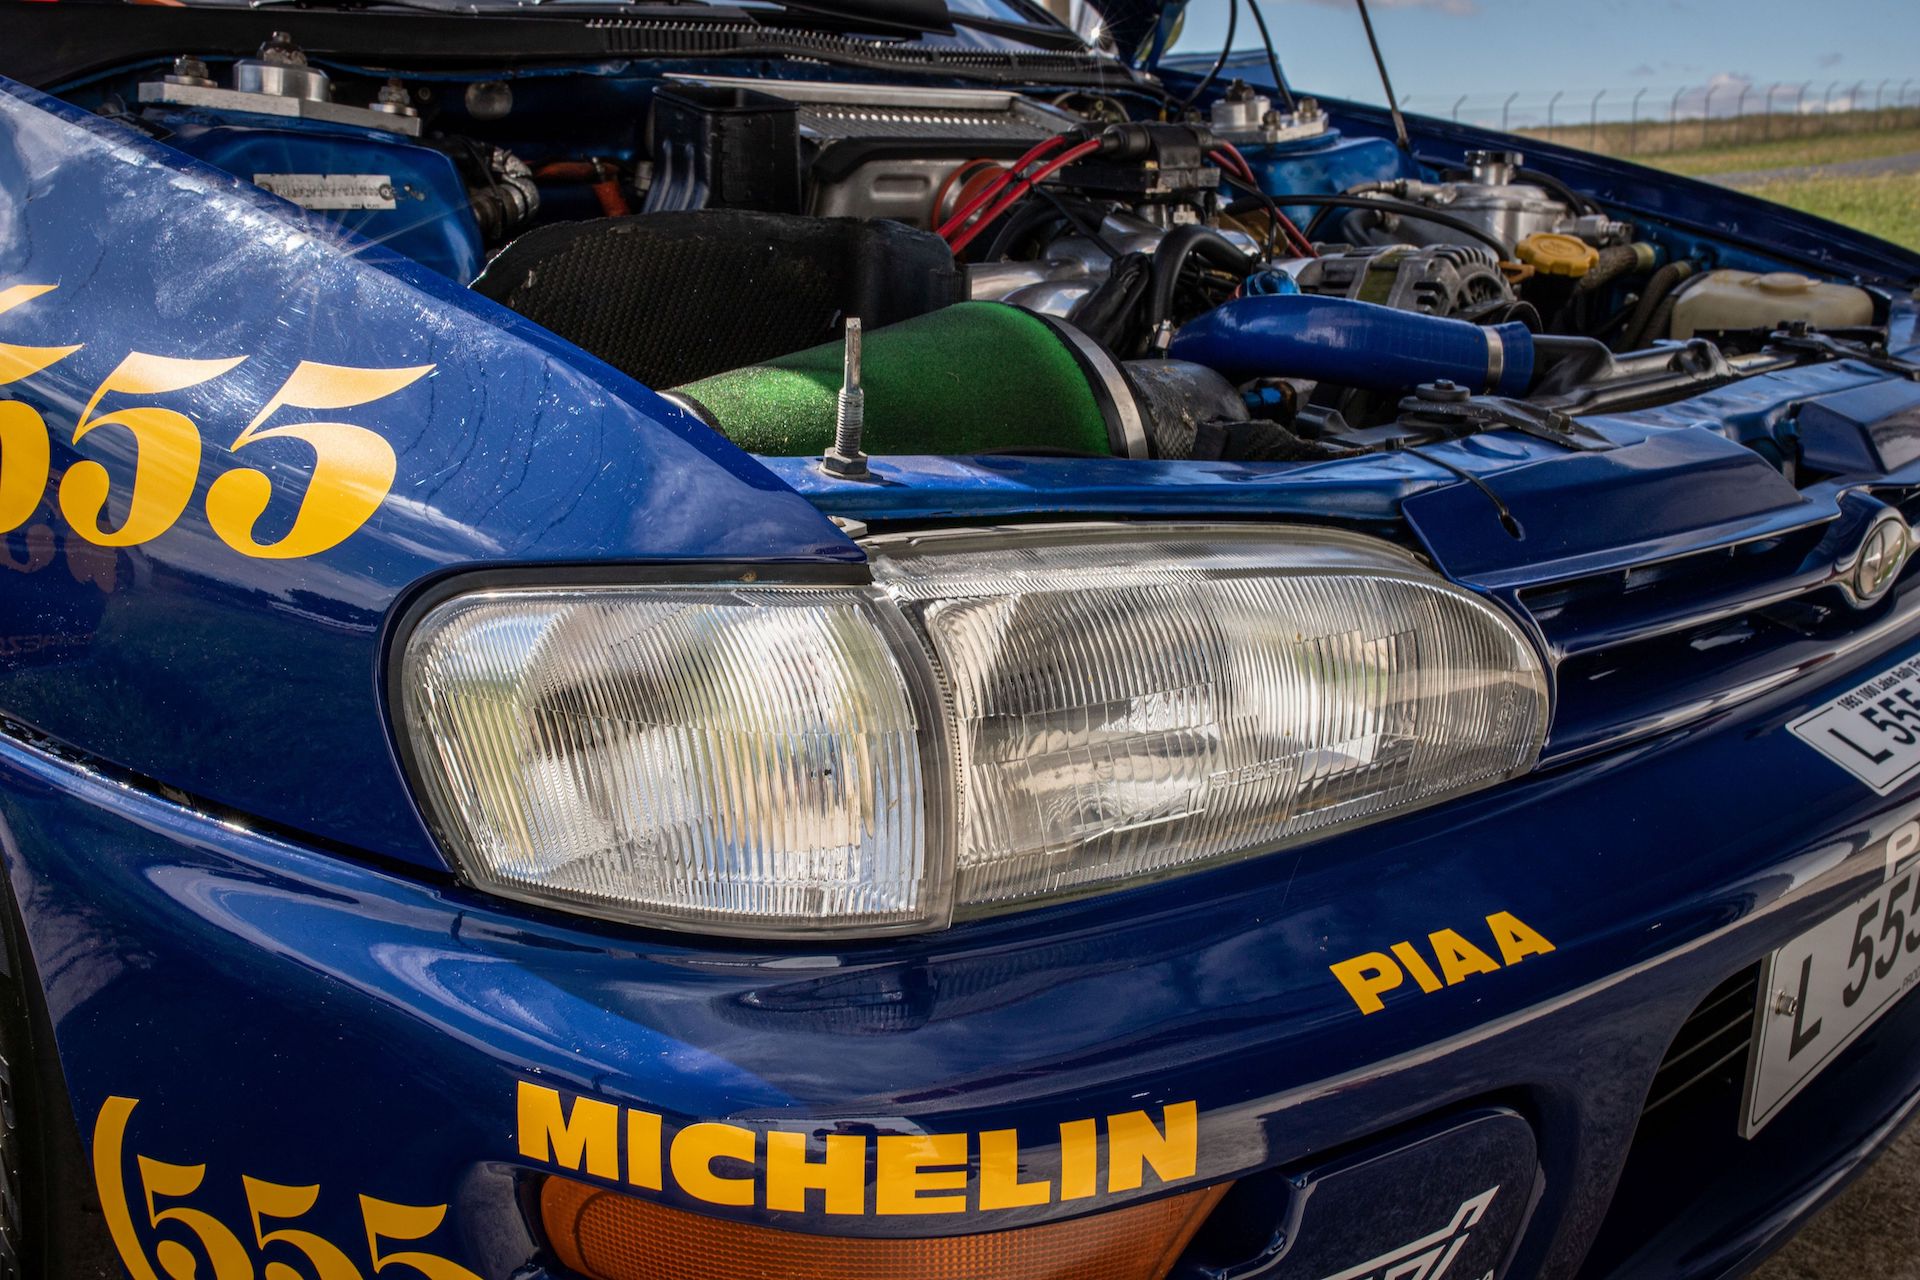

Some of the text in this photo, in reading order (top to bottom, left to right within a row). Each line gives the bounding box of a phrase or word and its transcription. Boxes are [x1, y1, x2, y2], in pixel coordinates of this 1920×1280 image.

[1828, 728, 1894, 765] L
[1329, 910, 1557, 1016] PIAA
[1788, 953, 1822, 1062] L
[517, 1080, 1198, 1216] MICHELIN
